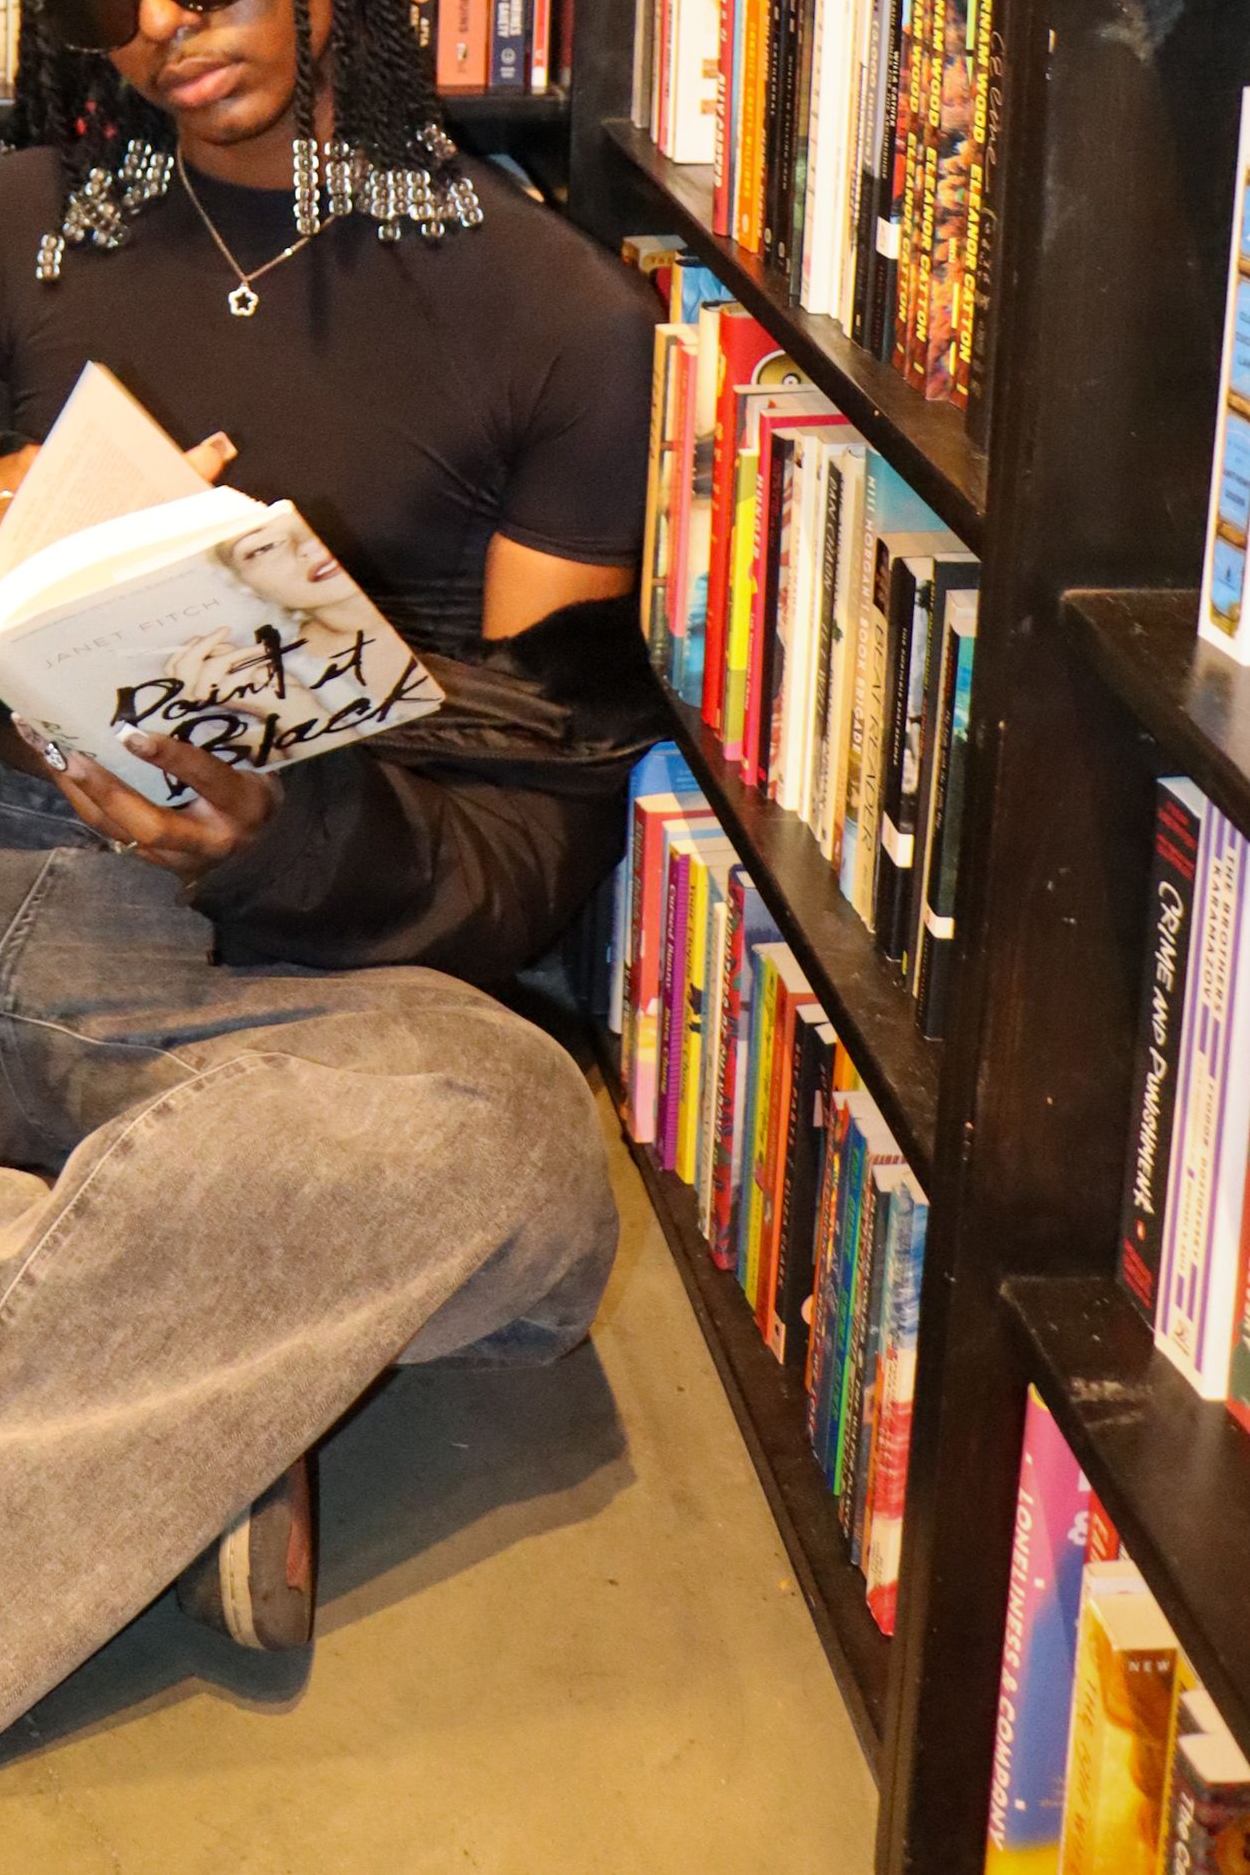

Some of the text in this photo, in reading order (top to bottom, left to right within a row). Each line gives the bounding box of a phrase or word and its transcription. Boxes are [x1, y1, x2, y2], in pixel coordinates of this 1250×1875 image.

[908, 45, 923, 113] WOOD
[926, 56, 944, 128] WOOD
[971, 71, 989, 145] WOOD
[896, 131, 918, 324] ELEANOR CATTON
[914, 146, 939, 342] ELEANOR CATTON
[958, 163, 984, 365] ELEANOR CATTON
[41, 629, 125, 672] JANET
[138, 595, 223, 634] FITCH
[110, 624, 376, 727] Paint it
[1200, 865, 1223, 1000] KARAMAZOV
[1211, 854, 1236, 1015] THE BROTHERS
[1132, 881, 1186, 1216] CRIME AND PUNISHMENT
[987, 1488, 1034, 1851] LONELINESS & COMPANY
[1128, 1660, 1172, 1673] NEW
